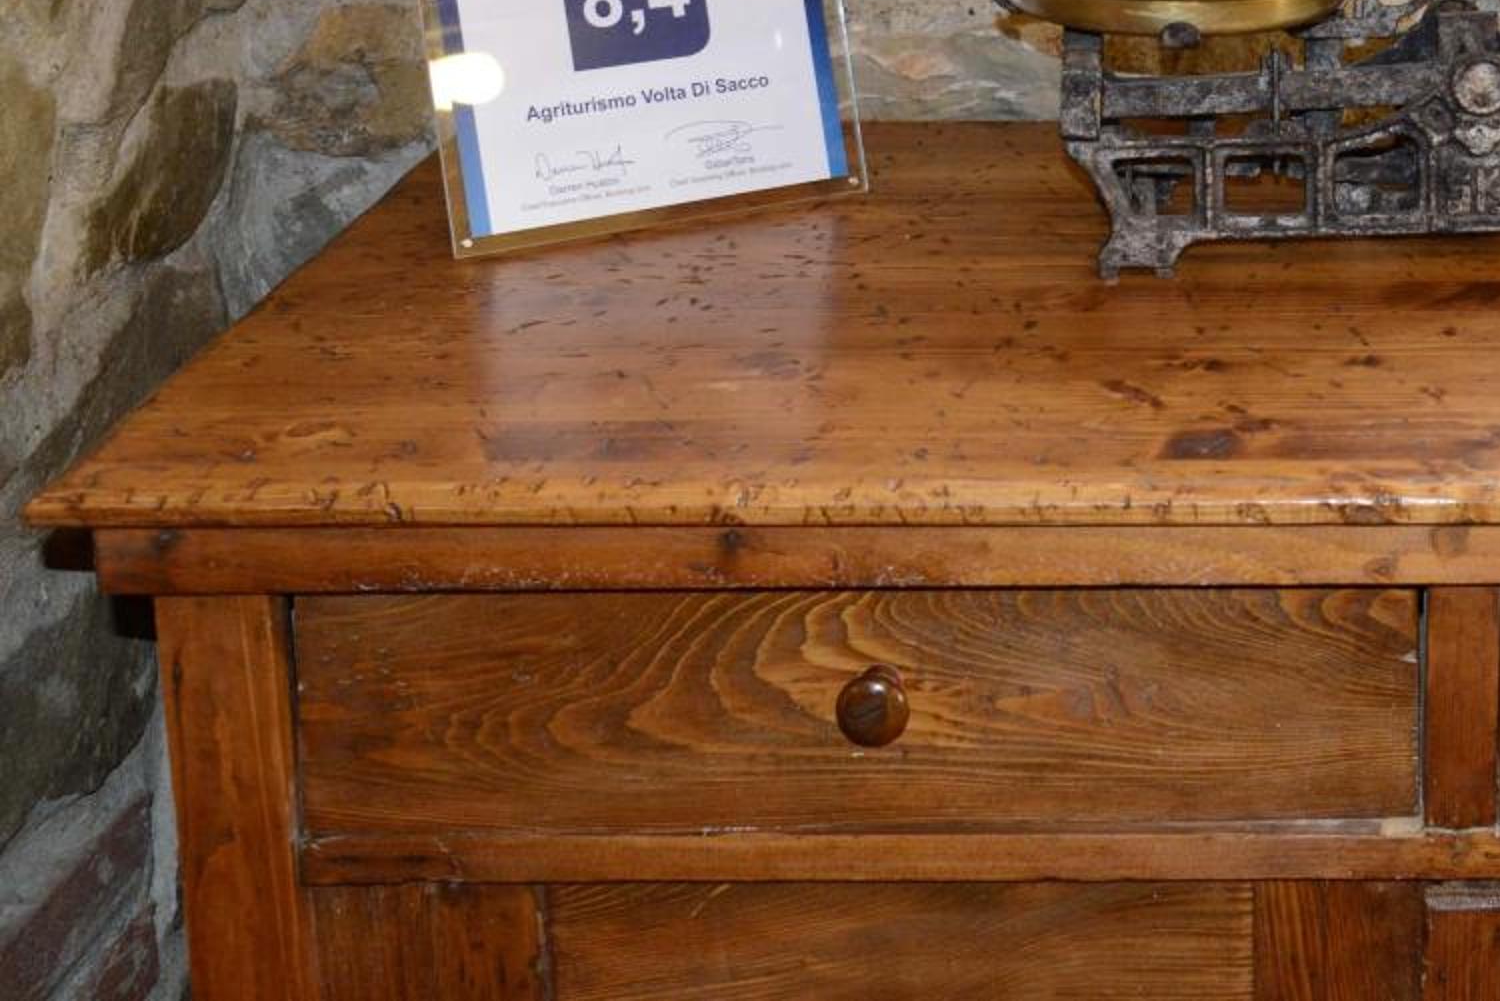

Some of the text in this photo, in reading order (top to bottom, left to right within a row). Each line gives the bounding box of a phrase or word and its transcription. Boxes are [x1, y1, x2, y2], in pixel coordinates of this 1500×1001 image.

[526, 75, 770, 124] Agriturismo Volta Di Sacco
